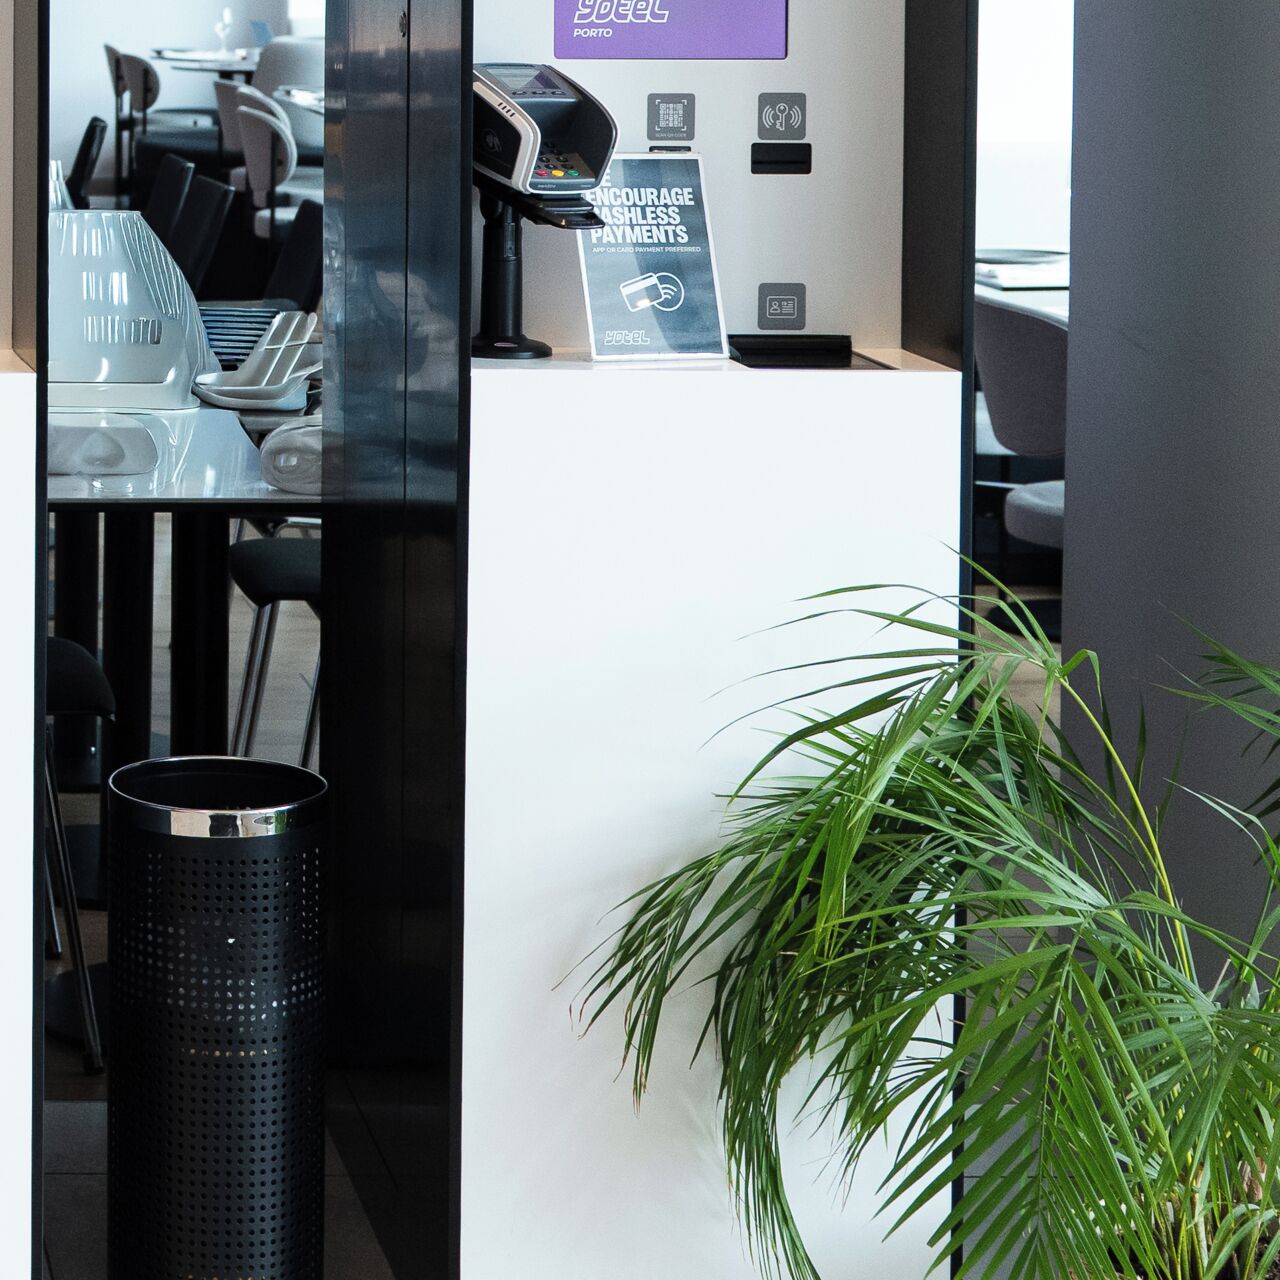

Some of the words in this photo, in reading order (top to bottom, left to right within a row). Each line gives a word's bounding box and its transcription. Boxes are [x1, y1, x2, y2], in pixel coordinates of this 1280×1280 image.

[573, 28, 613, 38] PORTO
[586, 187, 695, 206] ENCOURAGE
[591, 225, 689, 244] PAYMENTS
